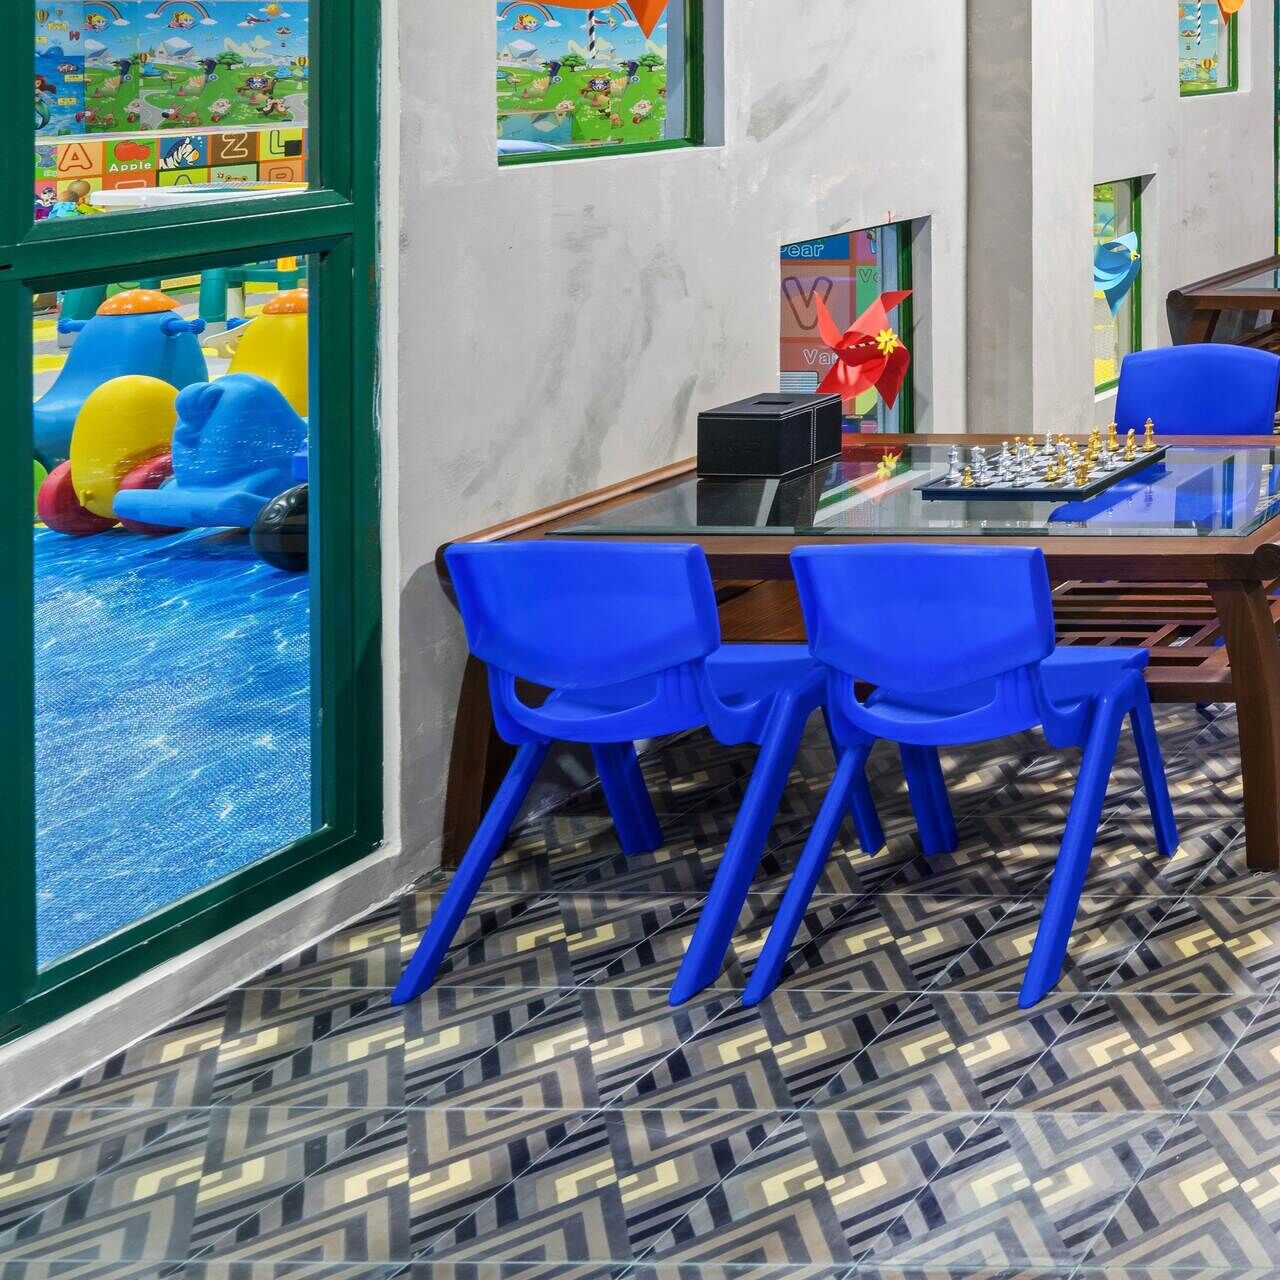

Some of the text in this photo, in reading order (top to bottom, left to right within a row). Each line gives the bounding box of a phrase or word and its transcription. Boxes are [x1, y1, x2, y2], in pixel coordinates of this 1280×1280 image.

[58, 143, 93, 172] A
[220, 132, 249, 159] Z
[109, 161, 152, 173] Apple
[782, 276, 834, 330] V
